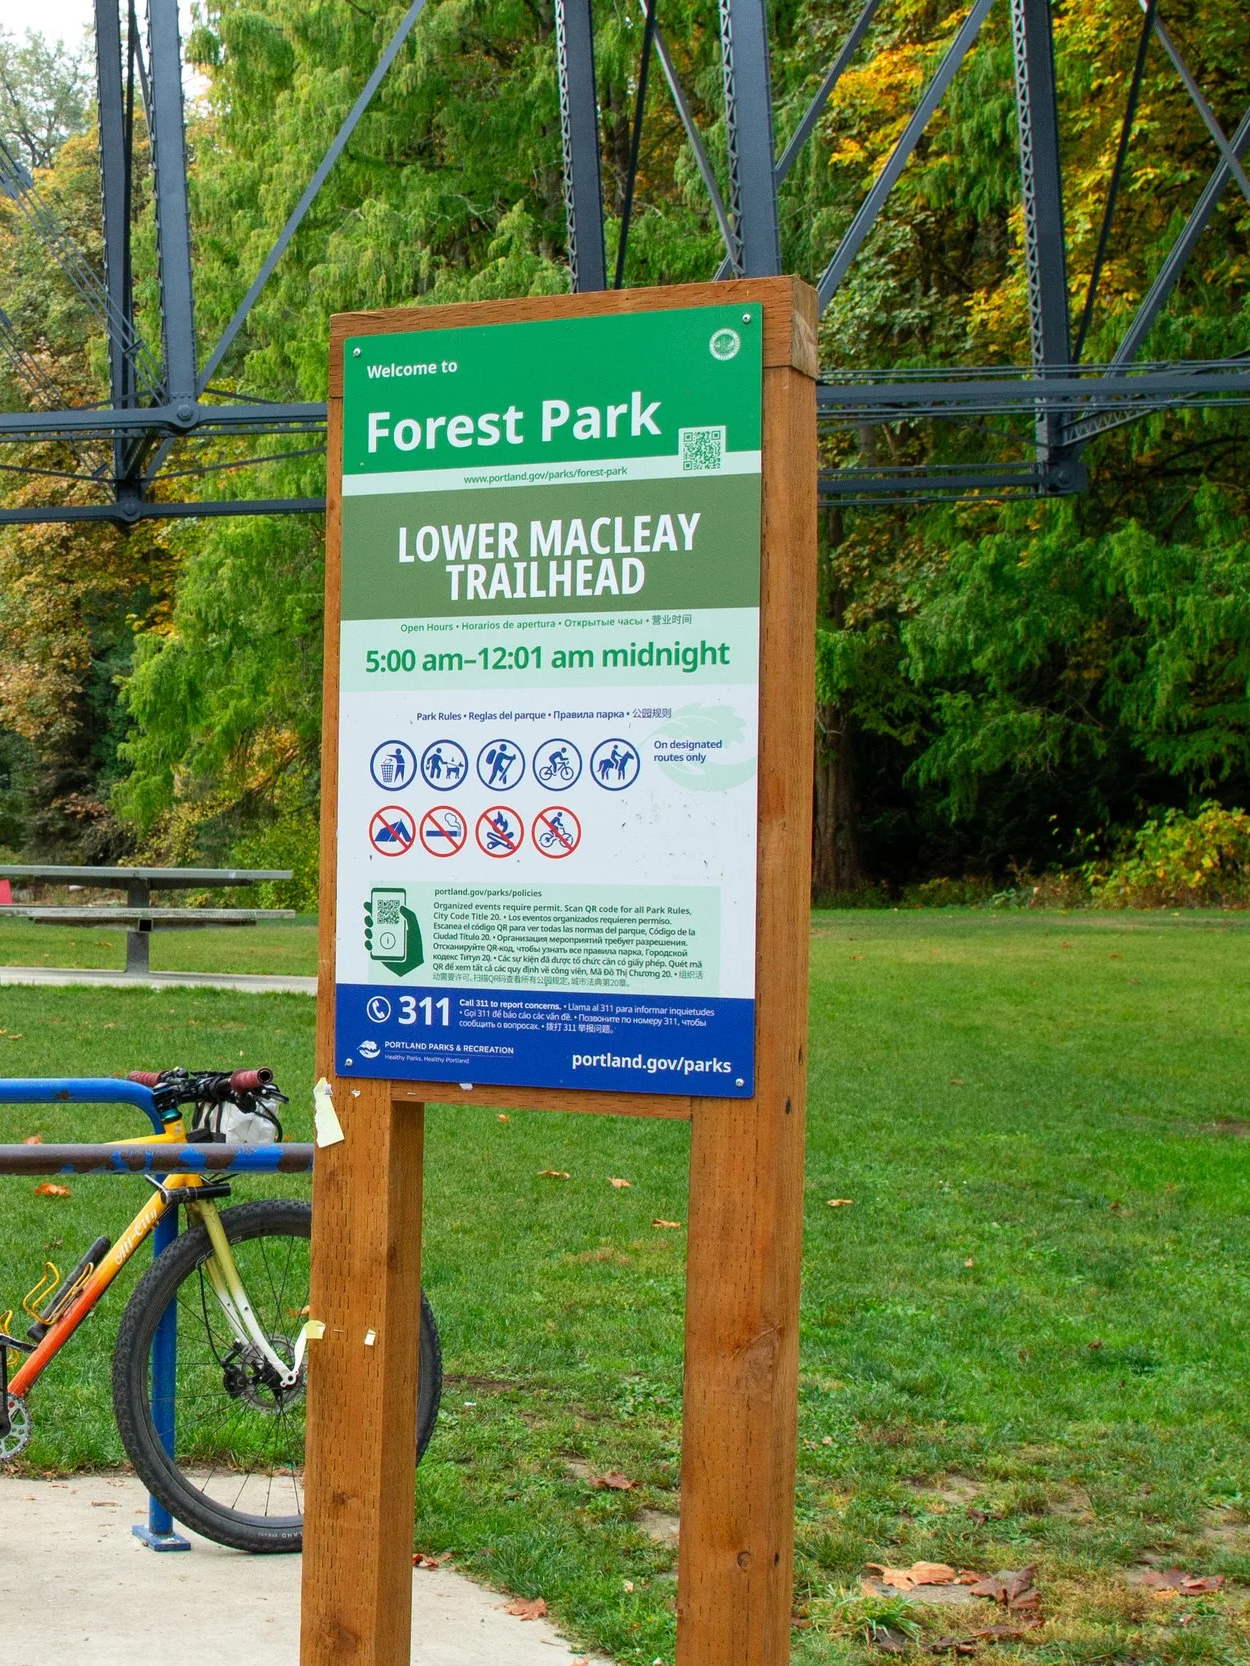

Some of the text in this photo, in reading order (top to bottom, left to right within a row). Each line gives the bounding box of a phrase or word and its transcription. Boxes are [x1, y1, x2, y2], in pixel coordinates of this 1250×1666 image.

[366, 359, 457, 379] Welcome to
[368, 391, 661, 453] Forest Park
[464, 466, 627, 484] www.portland.gov/parks/forest-park
[398, 511, 702, 564] LOWER MACLEAY
[444, 555, 646, 602] TRAILHEAD
[401, 624, 424, 634] Open
[462, 621, 500, 630] Horarios
[503, 621, 514, 629] de
[517, 621, 555, 630] apertura
[564, 619, 615, 628] Открытые
[651, 613, 693, 627] 营业时间
[366, 649, 416, 672] 5:00
[551, 650, 594, 668] am
[602, 640, 730, 673] midnight
[417, 708, 672, 722] Park Rules Reglas del parque Правила парка 公园规则
[654, 740, 722, 751] On designated
[654, 753, 706, 763] routes only
[435, 888, 542, 898] portland.gov/parks/policies
[434, 902, 473, 911] Organized
[503, 904, 531, 912] require
[533, 904, 562, 913] permit.
[585, 905, 597, 913] QR
[668, 907, 692, 915] Rules,
[434, 912, 448, 921] City
[450, 912, 470, 920] Code
[553, 915, 598, 924] organizados
[600, 916, 637, 925] requieren
[638, 917, 671, 926] permiso.
[433, 922, 462, 930] Escanea
[471, 923, 495, 932] código
[497, 924, 508, 932] QR
[563, 925, 573, 933] las
[618, 928, 647, 936] parque,
[649, 928, 676, 937] Código
[677, 928, 687, 936] de
[433, 932, 458, 940] Ciudad
[433, 943, 485, 952] Отсканируйте
[542, 947, 568, 955] узнать
[584, 948, 616, 956] правила
[399, 996, 449, 1026] 311
[568, 1003, 590, 1011] Llama
[600, 1004, 613, 1012] 311
[635, 1005, 668, 1014] informar
[669, 1007, 715, 1016] inquietudes
[633, 1018, 662, 1027] номеру
[384, 1041, 427, 1050] PORTLAND
[428, 1042, 454, 1052] PARKS
[463, 1044, 514, 1055] RECREATION
[385, 1053, 405, 1061] Healthy
[424, 1055, 444, 1063] Healthy
[446, 1056, 469, 1064] Portland
[572, 1053, 731, 1075] portland.gov/parks
